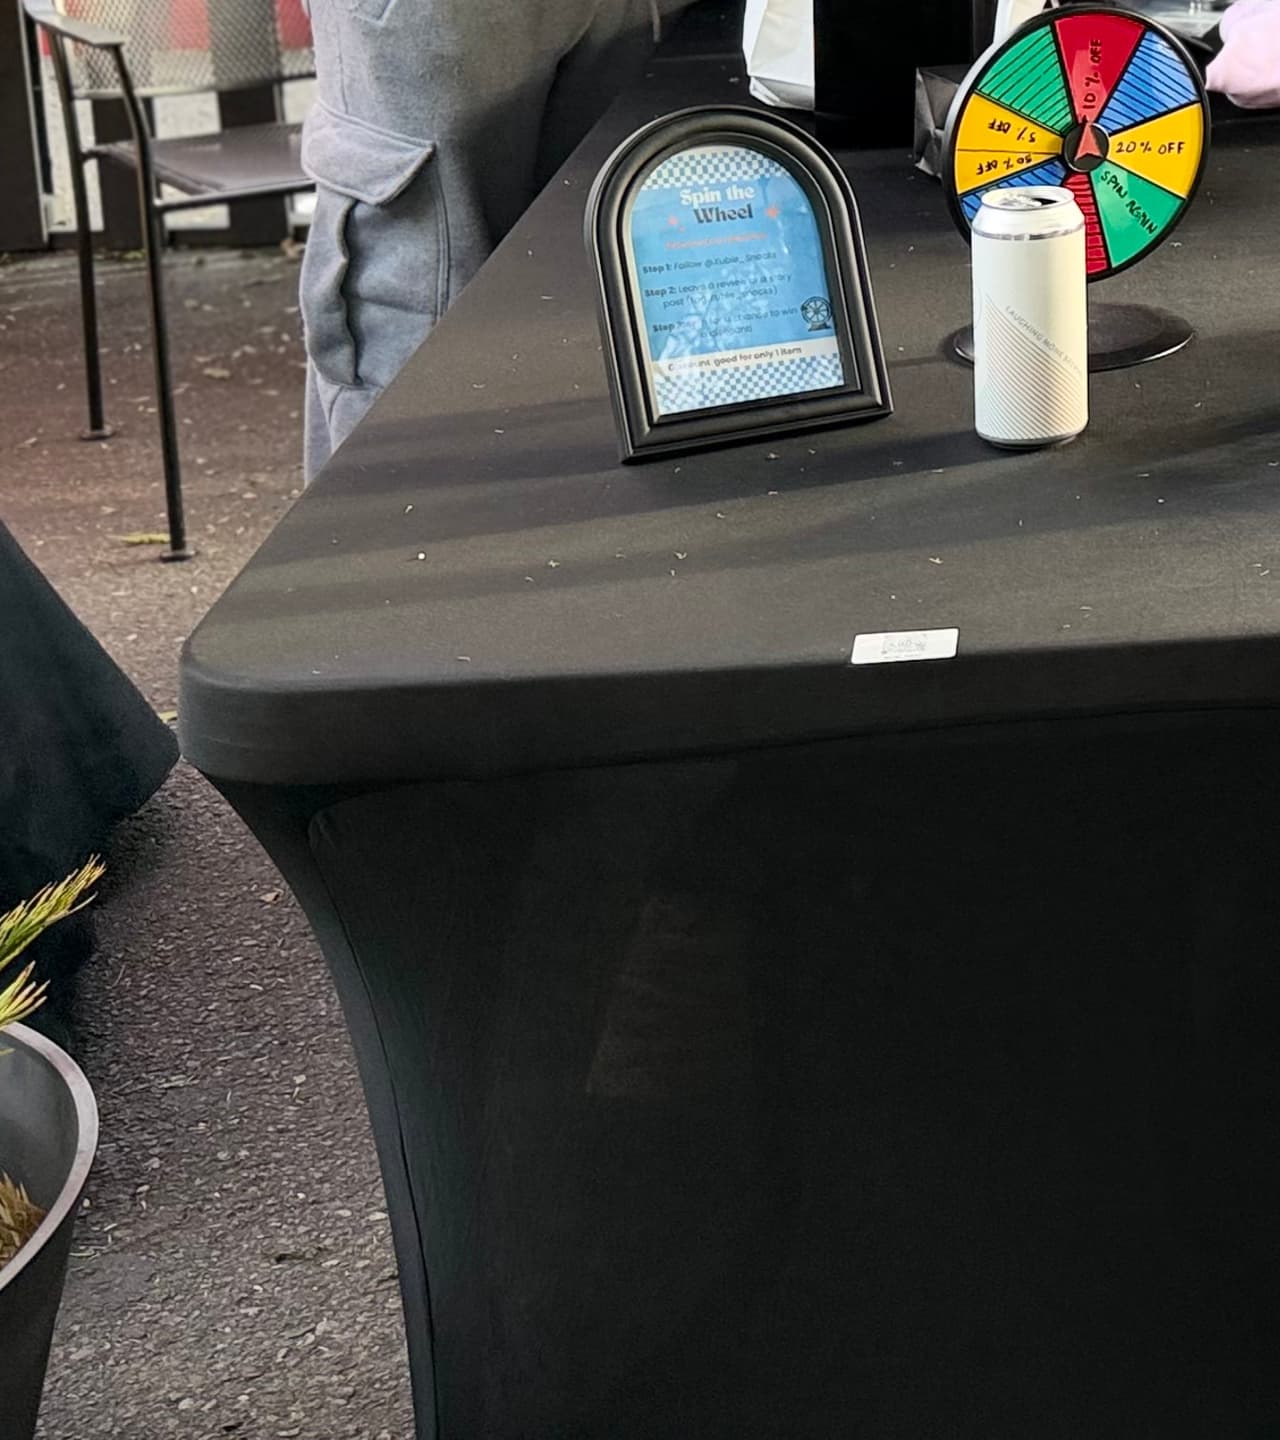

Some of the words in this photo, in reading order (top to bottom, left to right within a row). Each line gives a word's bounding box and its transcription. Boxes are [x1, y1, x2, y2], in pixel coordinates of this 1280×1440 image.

[1090, 38, 1102, 66] OFF
[987, 117, 1013, 134] OFF
[1157, 140, 1187, 156] OFF
[975, 157, 999, 176] OFF
[1100, 169, 1127, 200] SPIN
[680, 186, 722, 210] Spin
[726, 184, 755, 202] the
[693, 203, 754, 225] Wheel
[1125, 199, 1159, 234] AGAIN
[644, 288, 667, 298] Step
[714, 352, 738, 366] good
[739, 351, 753, 362] for
[753, 349, 774, 361] only
